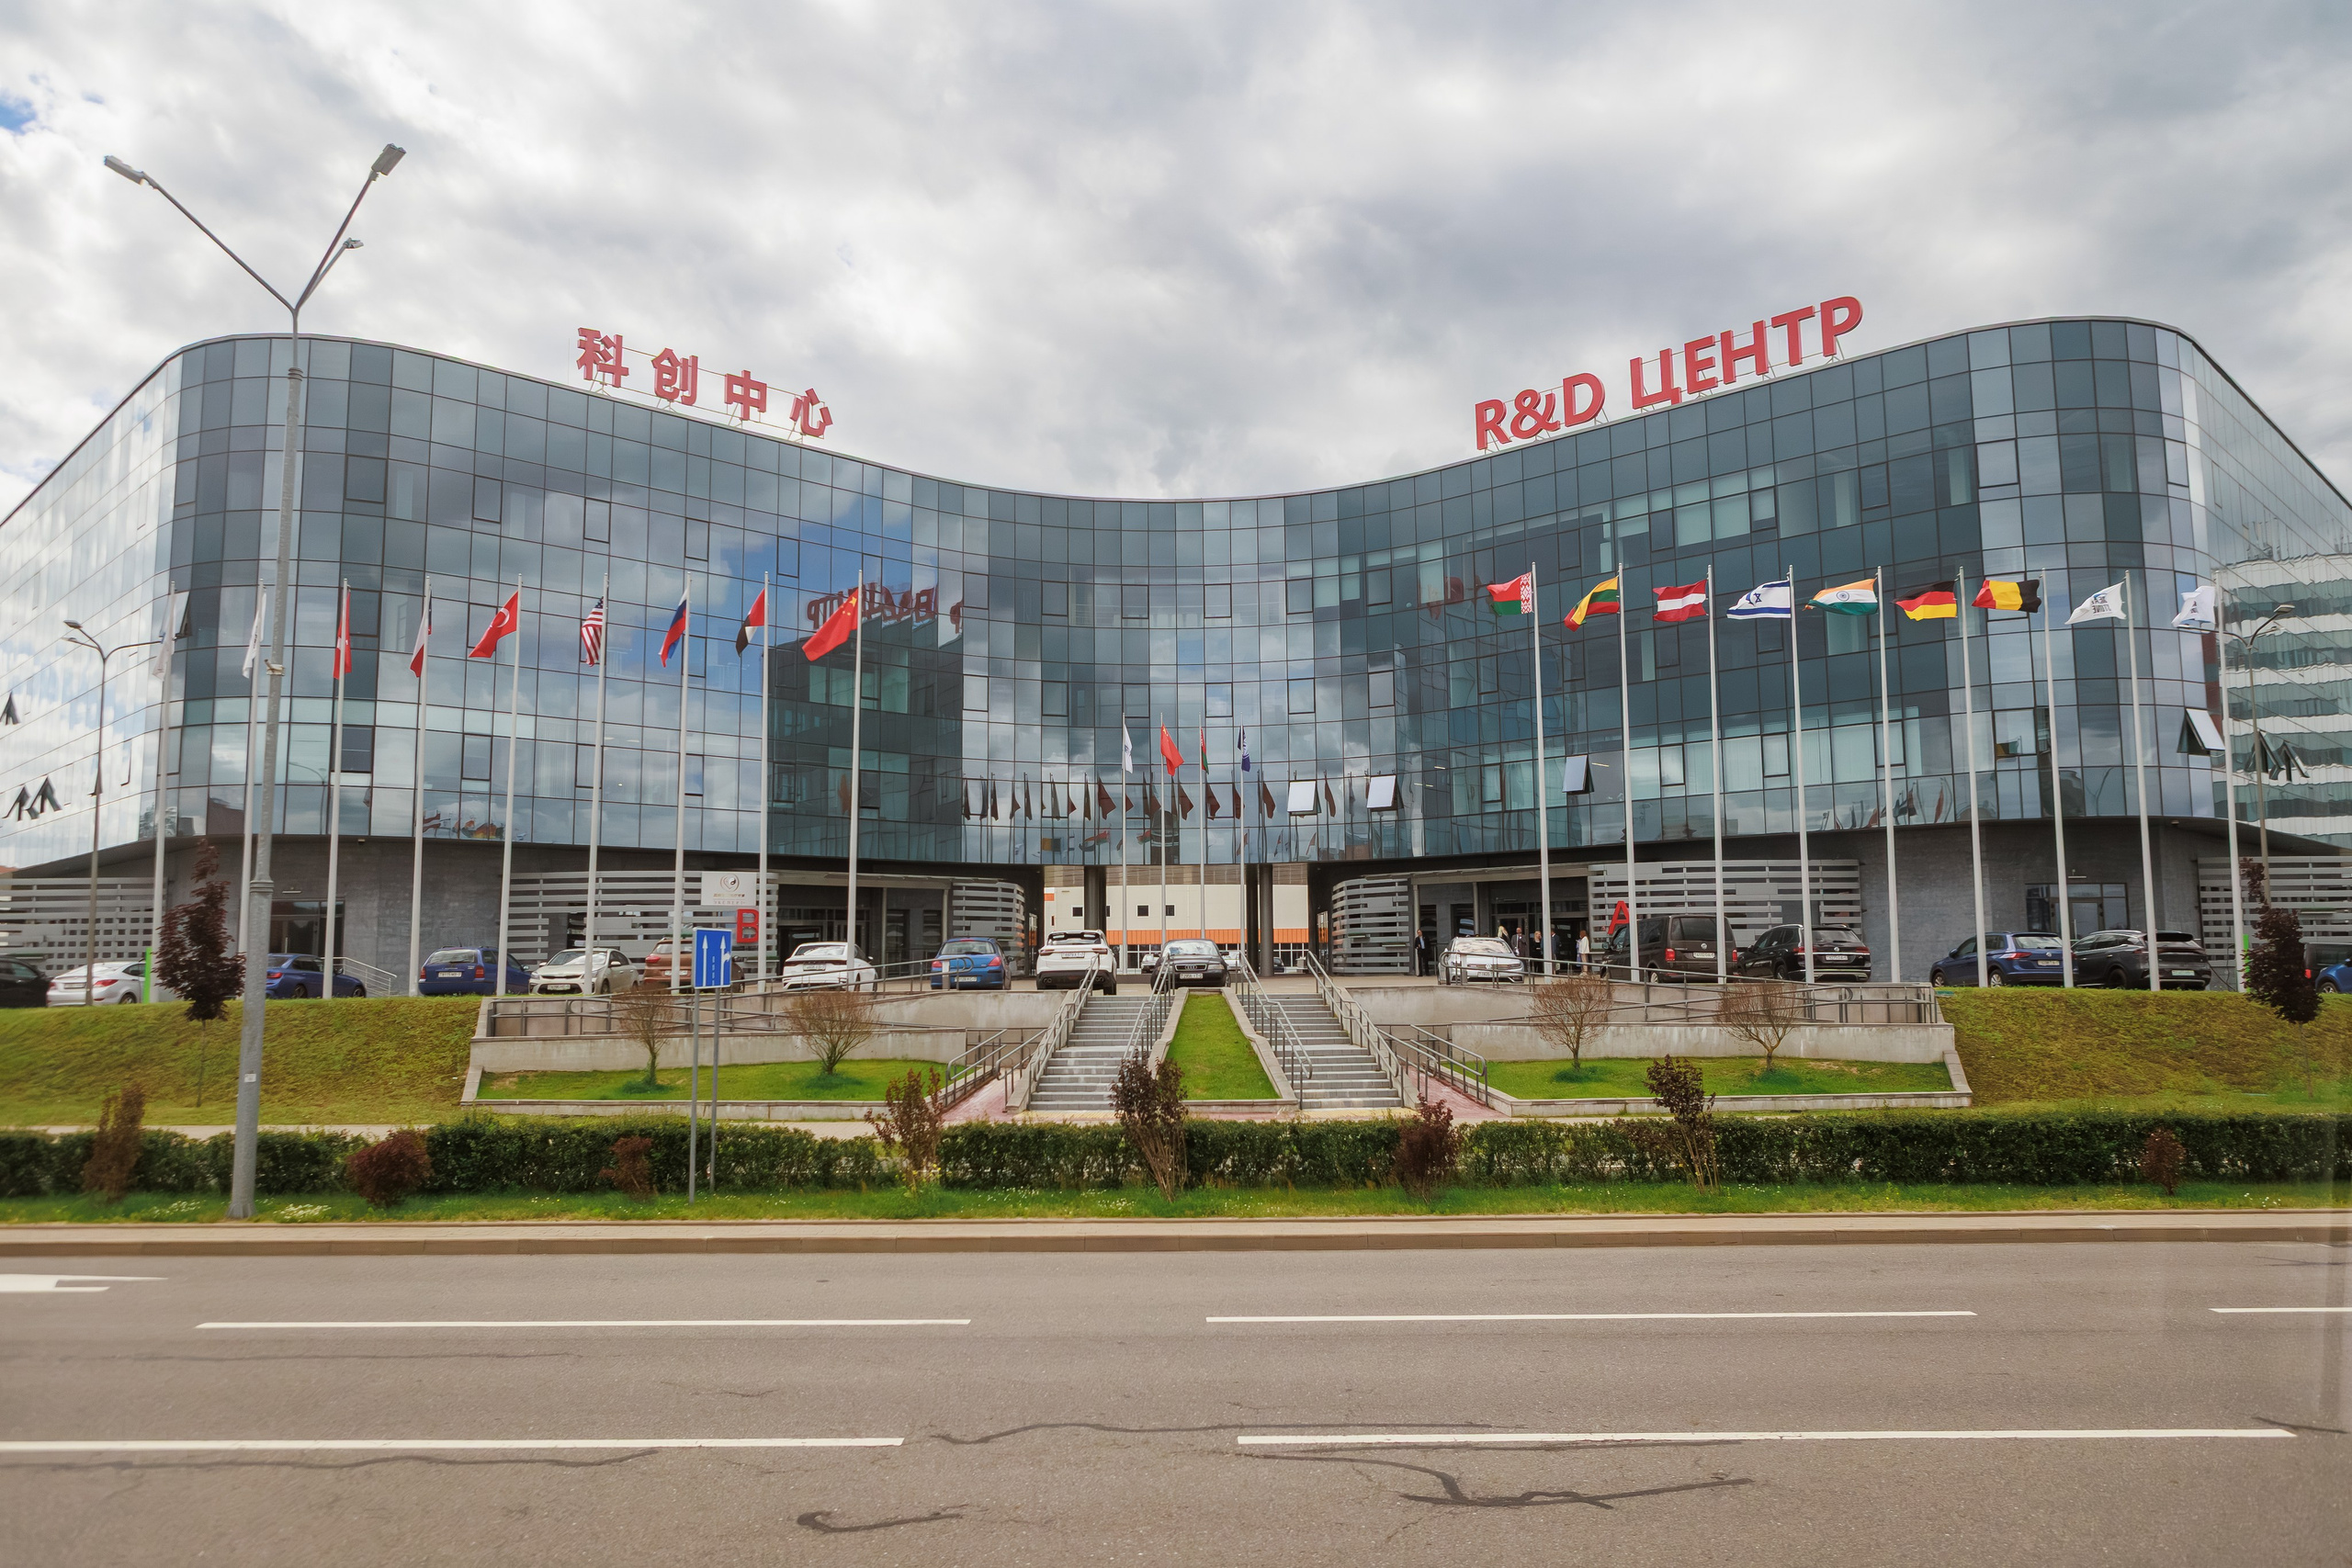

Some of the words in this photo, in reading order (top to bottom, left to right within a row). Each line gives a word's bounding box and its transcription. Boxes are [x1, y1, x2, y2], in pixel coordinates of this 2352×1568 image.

[576, 327, 833, 438] 科创中心
[1475, 372, 1605, 451] R&D
[1629, 296, 1863, 411] ЦЕНТР
